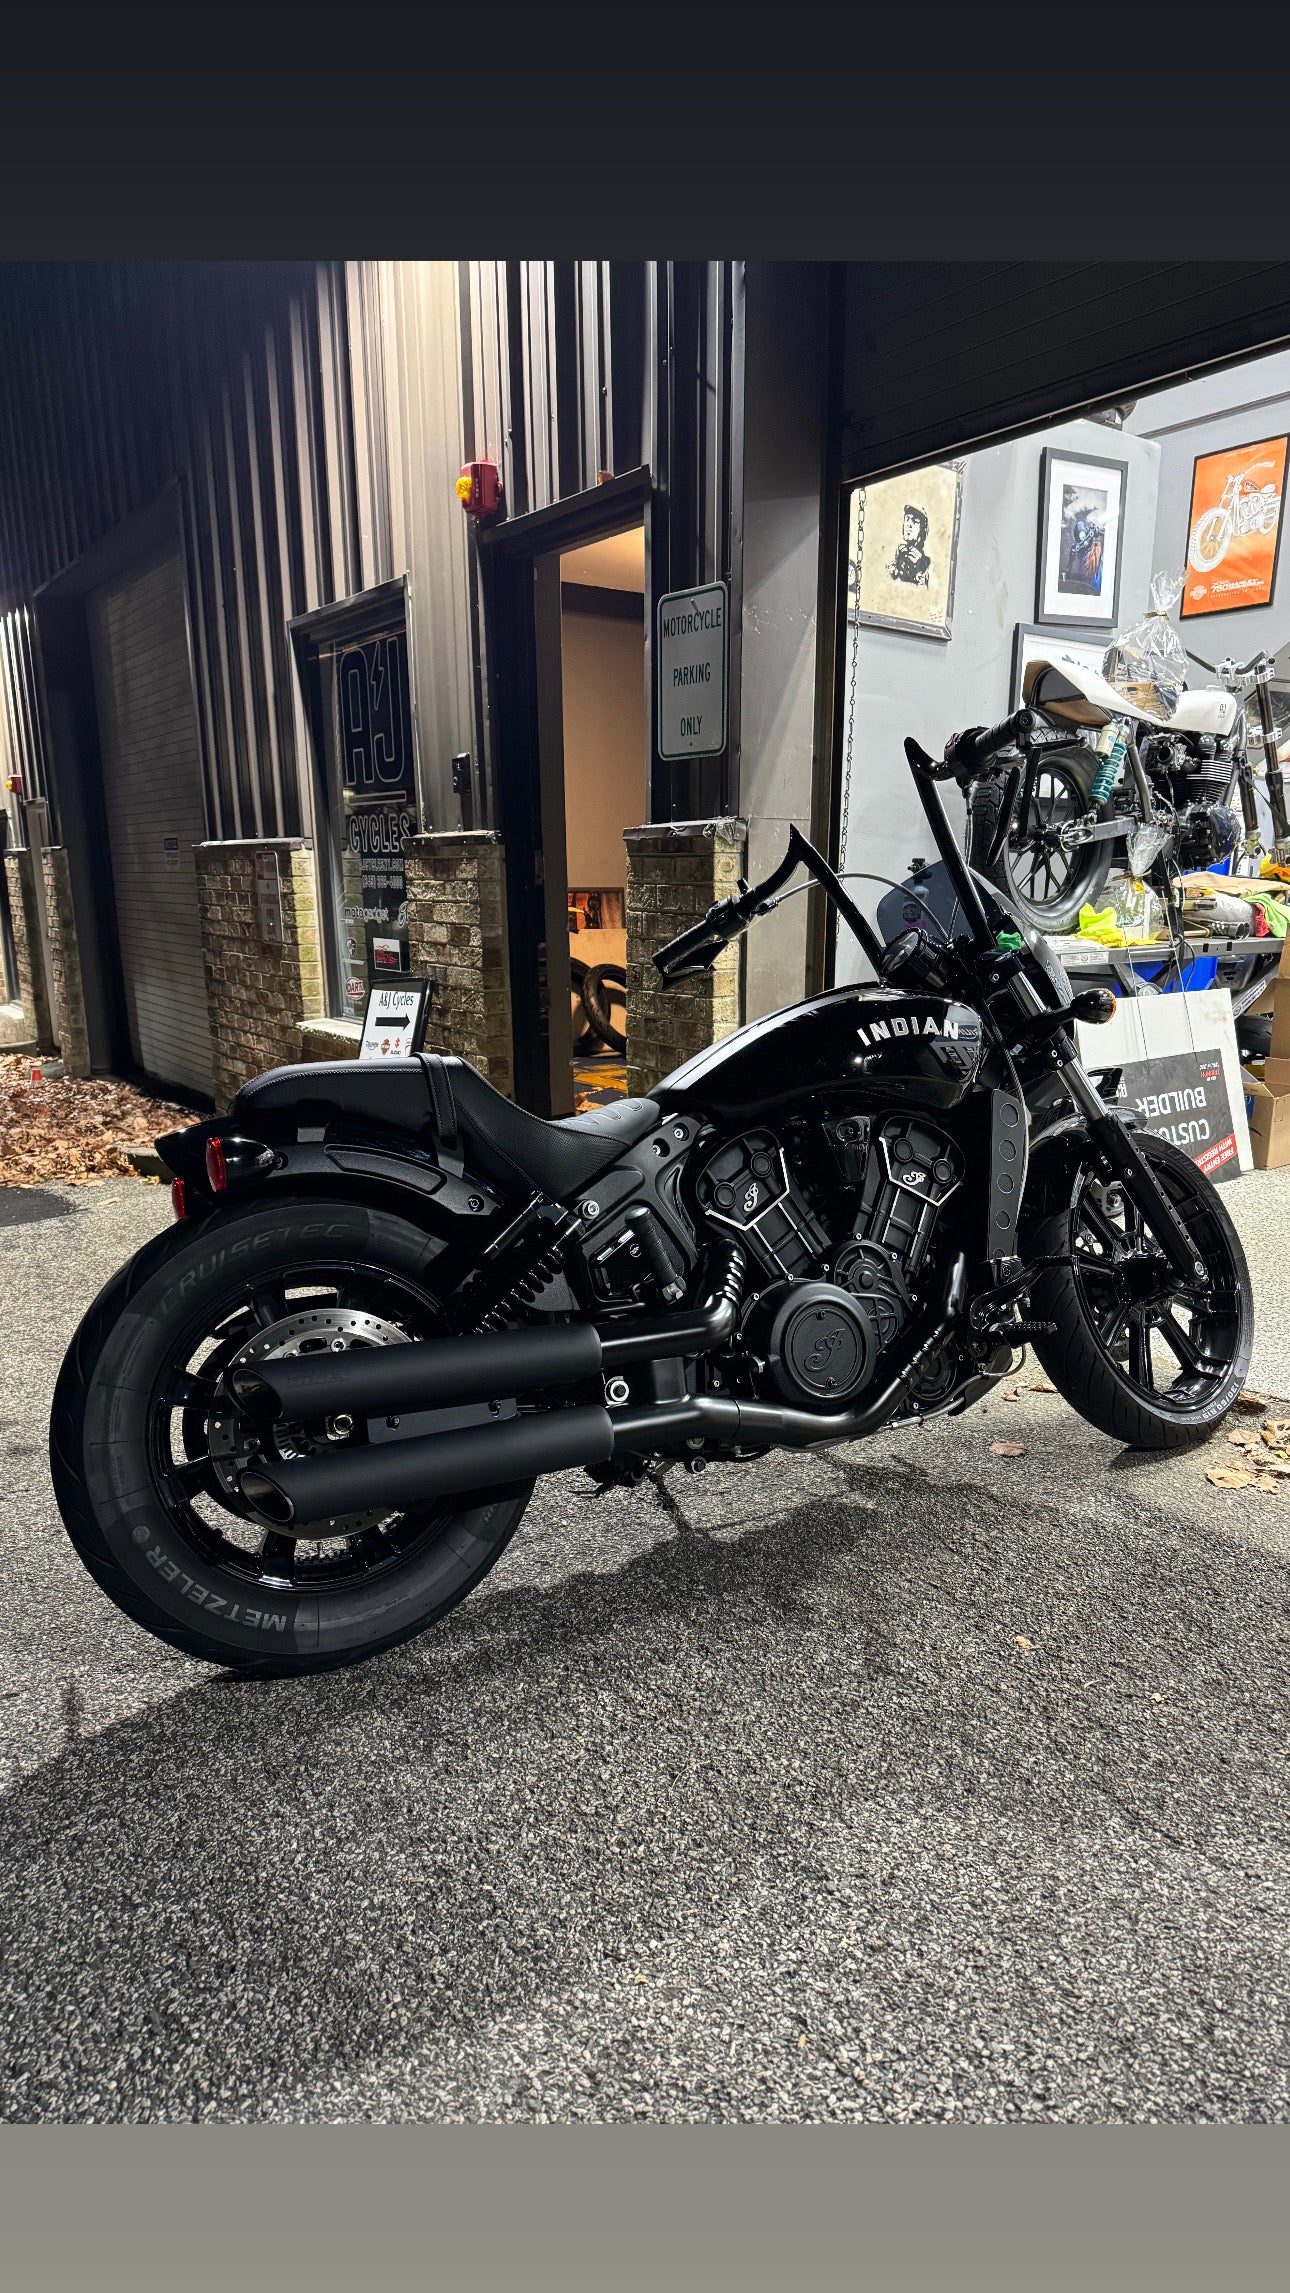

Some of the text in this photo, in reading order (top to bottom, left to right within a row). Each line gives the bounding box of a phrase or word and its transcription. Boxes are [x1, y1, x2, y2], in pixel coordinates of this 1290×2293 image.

[663, 607, 722, 638] MOTORCYCLE
[673, 662, 711, 687] PARKING
[680, 715, 703, 737] ONLY
[349, 813, 411, 853] CYCLES
[379, 992, 414, 1010] A&J Cycles
[857, 1017, 958, 1046] INDIAN
[1135, 1086, 1207, 1118] BUILDER
[1155, 1118, 1210, 1146] CUSTO
[1195, 1138, 1233, 1166] WITH REGISTR
[1203, 1147, 1234, 1173] FREE ENTRY
[160, 1223, 349, 1314] CRUISETEC
[145, 1545, 286, 1632] METZELER
